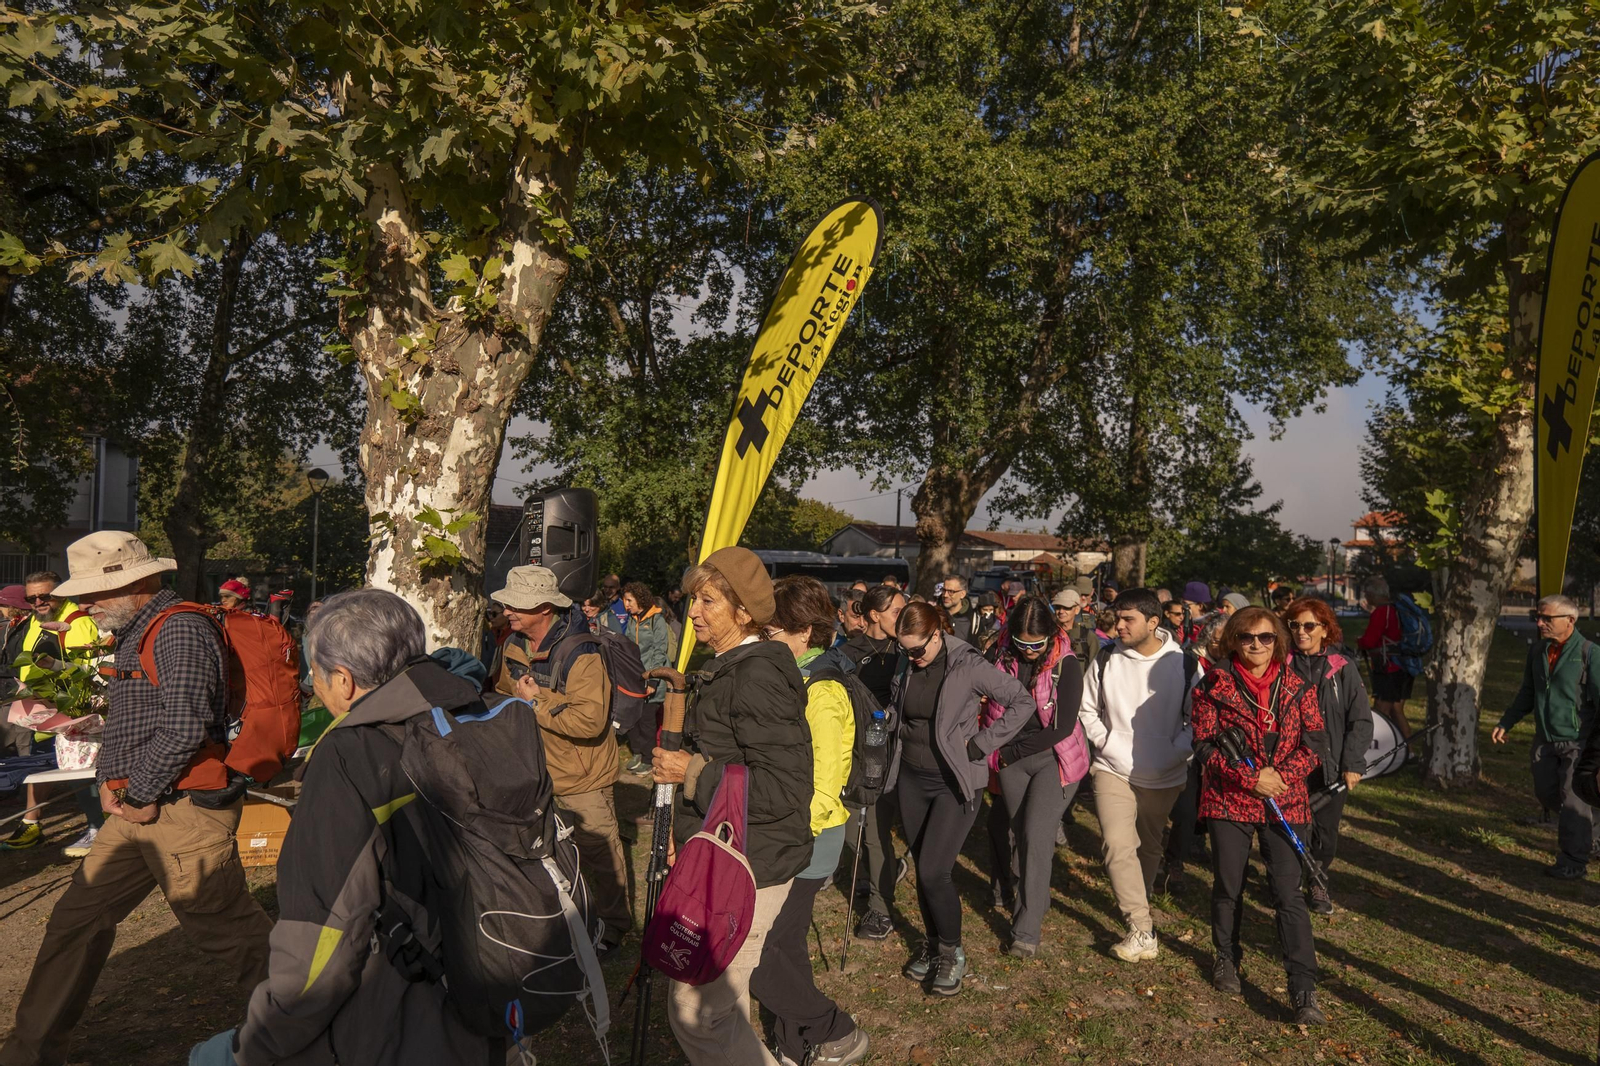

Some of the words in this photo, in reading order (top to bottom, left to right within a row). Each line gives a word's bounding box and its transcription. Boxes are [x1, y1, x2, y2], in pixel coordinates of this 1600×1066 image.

[768, 253, 853, 410] DEPORTE
[801, 344, 822, 373] La
[818, 265, 863, 341] Región
[669, 925, 700, 948] CULTURAIS
[673, 920, 701, 941] ROTEIROS
